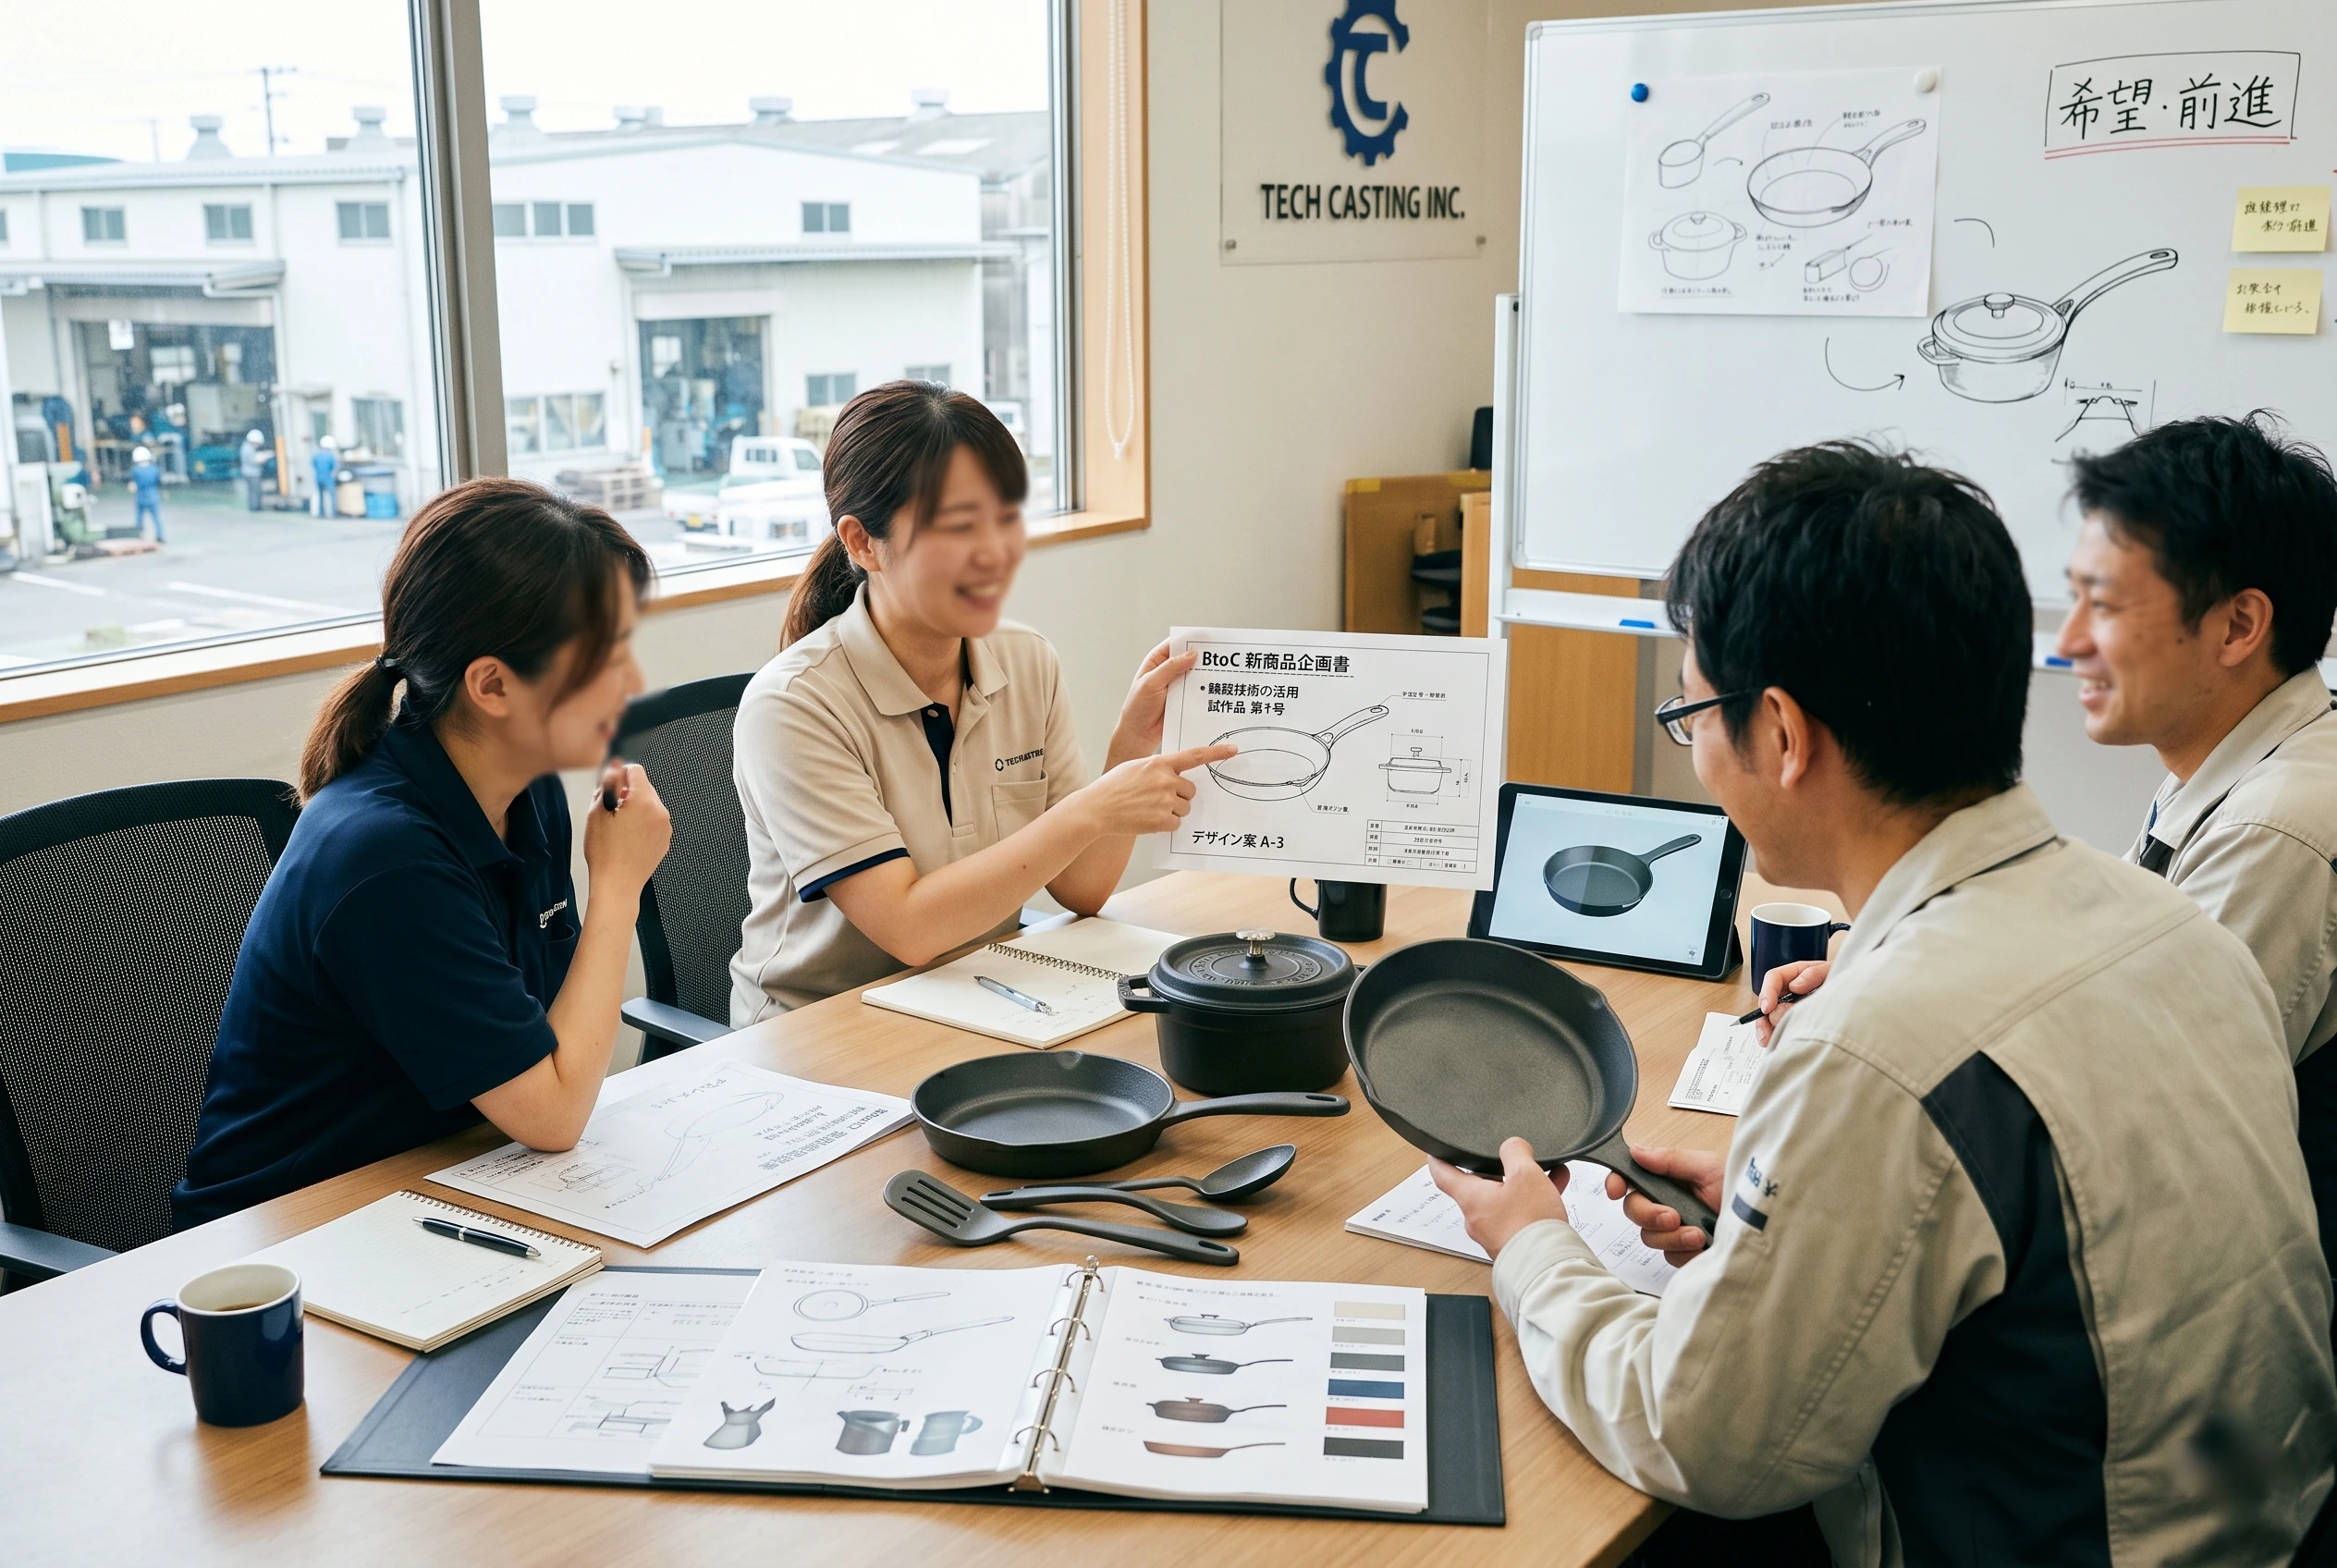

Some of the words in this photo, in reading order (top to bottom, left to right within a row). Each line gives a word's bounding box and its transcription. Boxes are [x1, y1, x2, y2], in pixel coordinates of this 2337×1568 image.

[1260, 183, 1321, 220] TECH
[1328, 184, 1421, 220] CASTING
[1426, 186, 1466, 219] INC.
[1202, 651, 1241, 668] BtoC
[1244, 652, 1350, 673] 新商品企画書
[1207, 699, 1246, 715] 試作品
[1192, 830, 1257, 848] デザイン案
[1259, 835, 1285, 849] A-3
